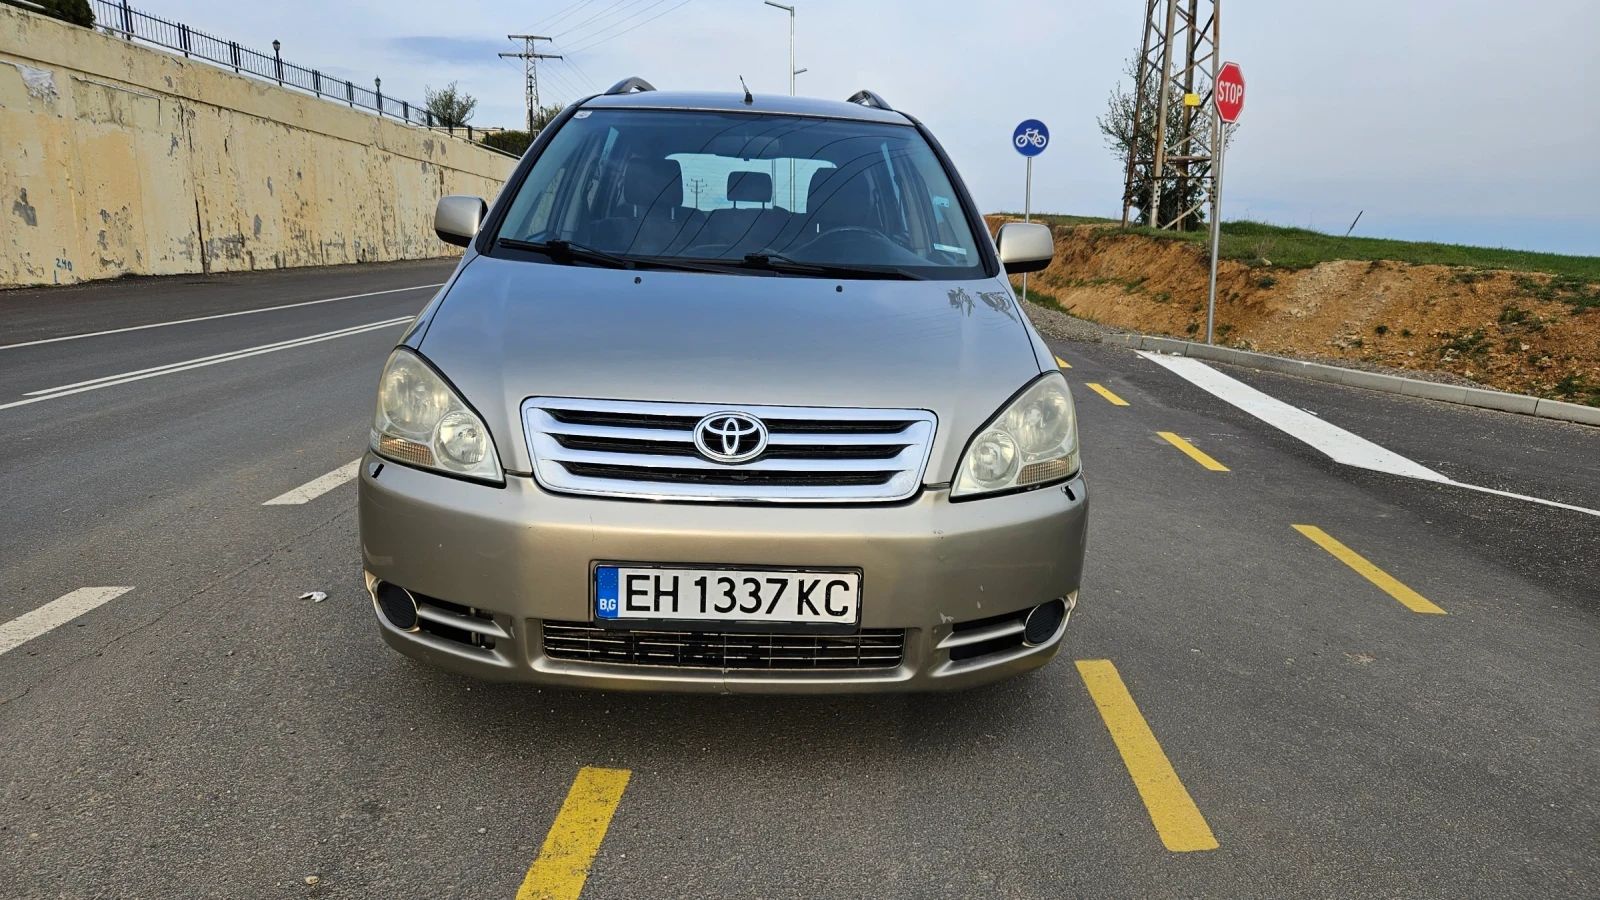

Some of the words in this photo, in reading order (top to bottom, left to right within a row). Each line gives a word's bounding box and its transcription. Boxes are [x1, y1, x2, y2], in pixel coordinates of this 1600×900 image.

[1218, 80, 1243, 104] STOP
[56, 257, 72, 271] 240
[626, 574, 679, 612] EH
[694, 576, 789, 614] 1337
[797, 579, 850, 616] KC
[599, 598, 617, 612] BG
